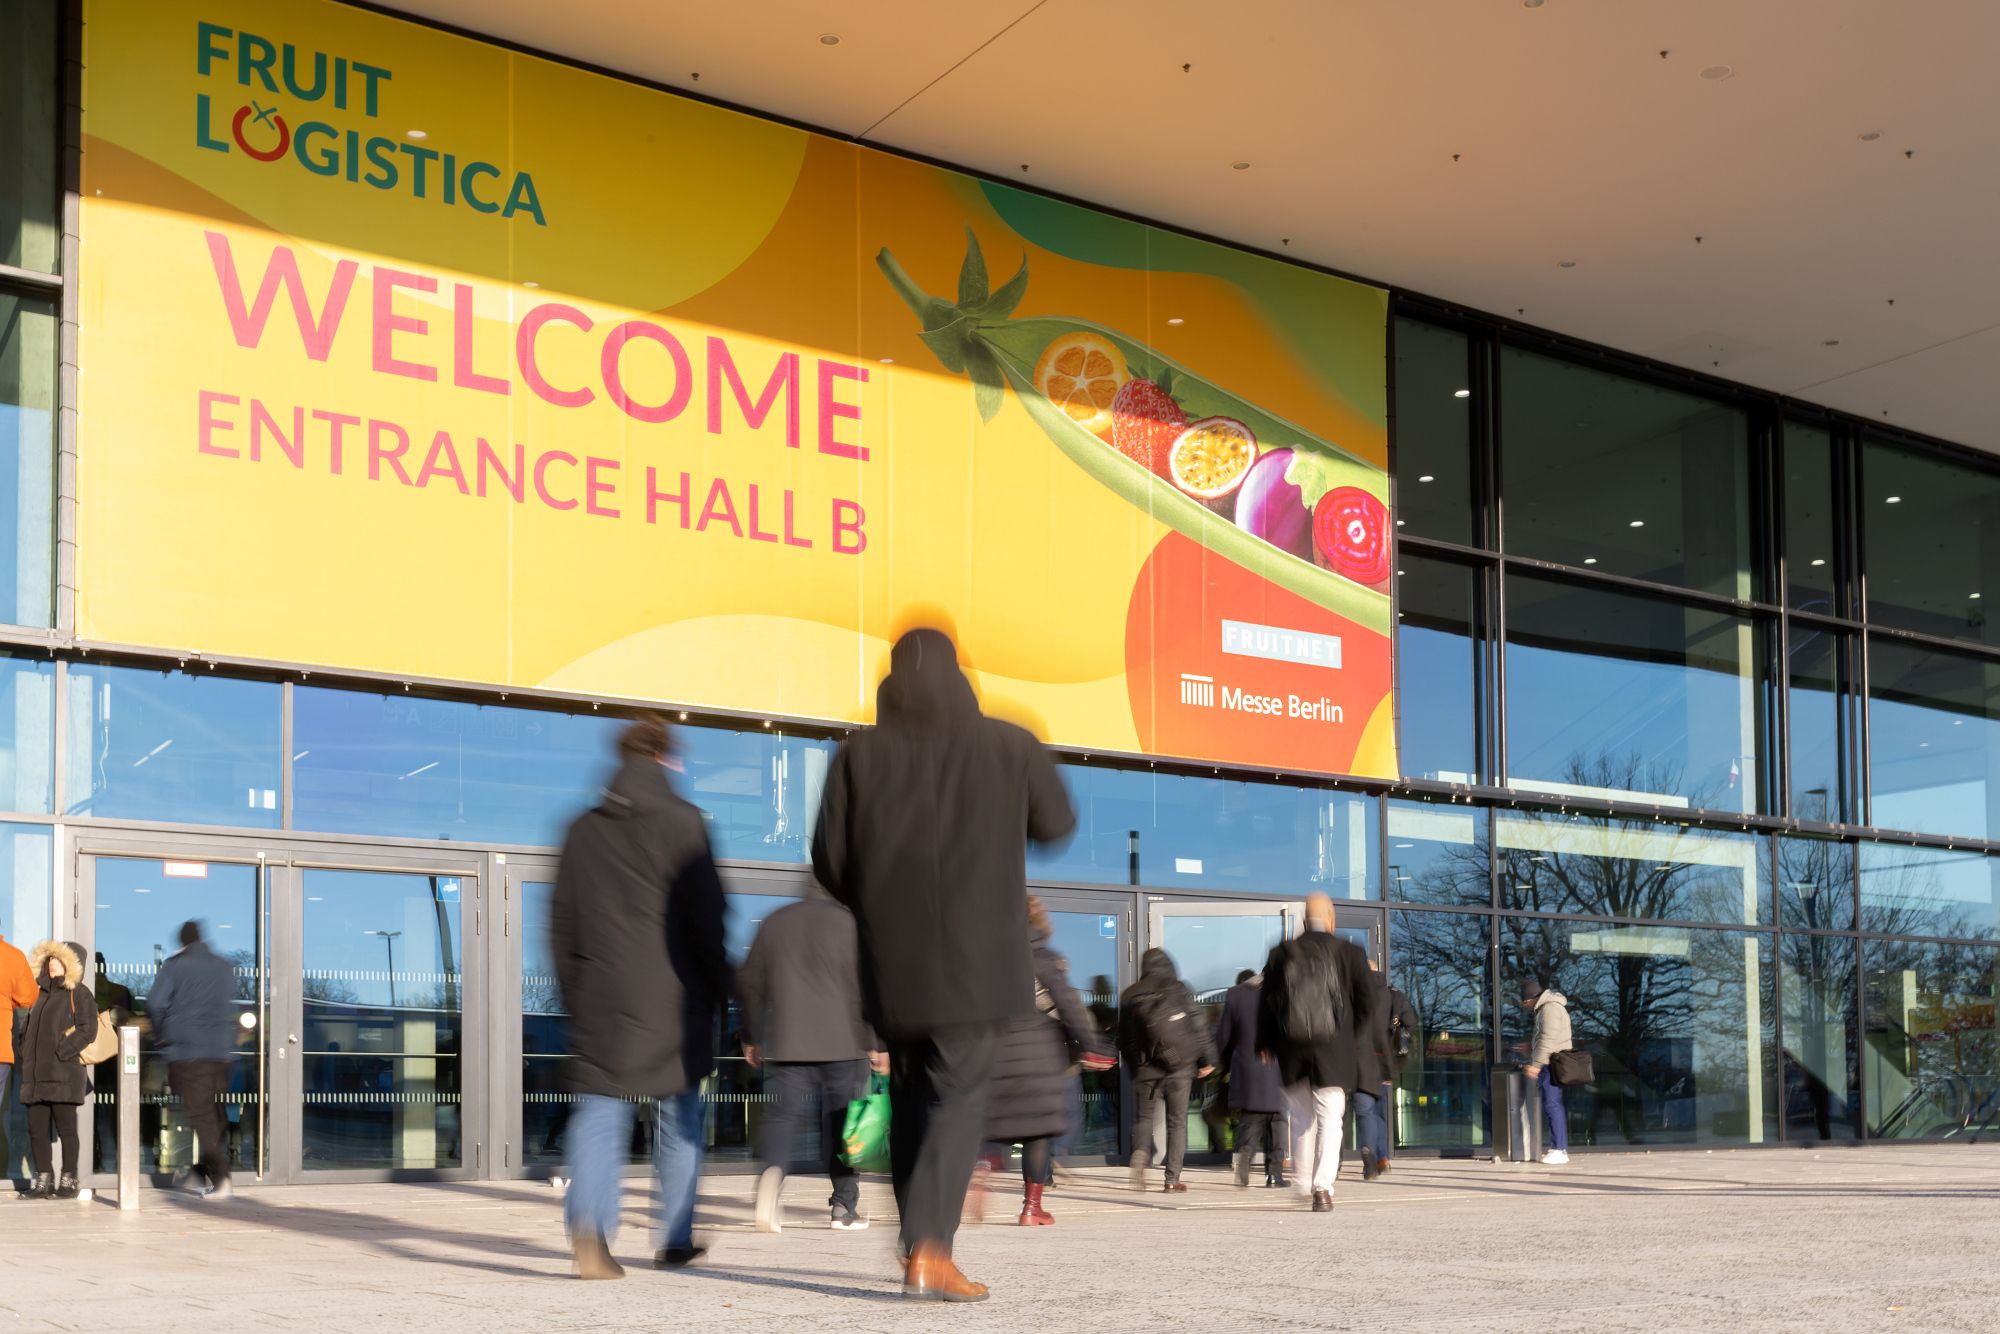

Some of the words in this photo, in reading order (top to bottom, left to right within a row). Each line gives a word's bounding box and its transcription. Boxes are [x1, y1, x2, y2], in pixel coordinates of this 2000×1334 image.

[198, 21, 392, 118] FRUIT
[197, 93, 547, 226] LOGISTICA
[203, 230, 870, 462] WELCOME
[198, 390, 621, 519] ENTRANCE
[646, 466, 812, 549] HALL
[832, 498, 868, 556] B
[1226, 627, 1338, 662] FRUITNET
[1221, 685, 1282, 716] Messe
[1288, 695, 1344, 723] Berlin
